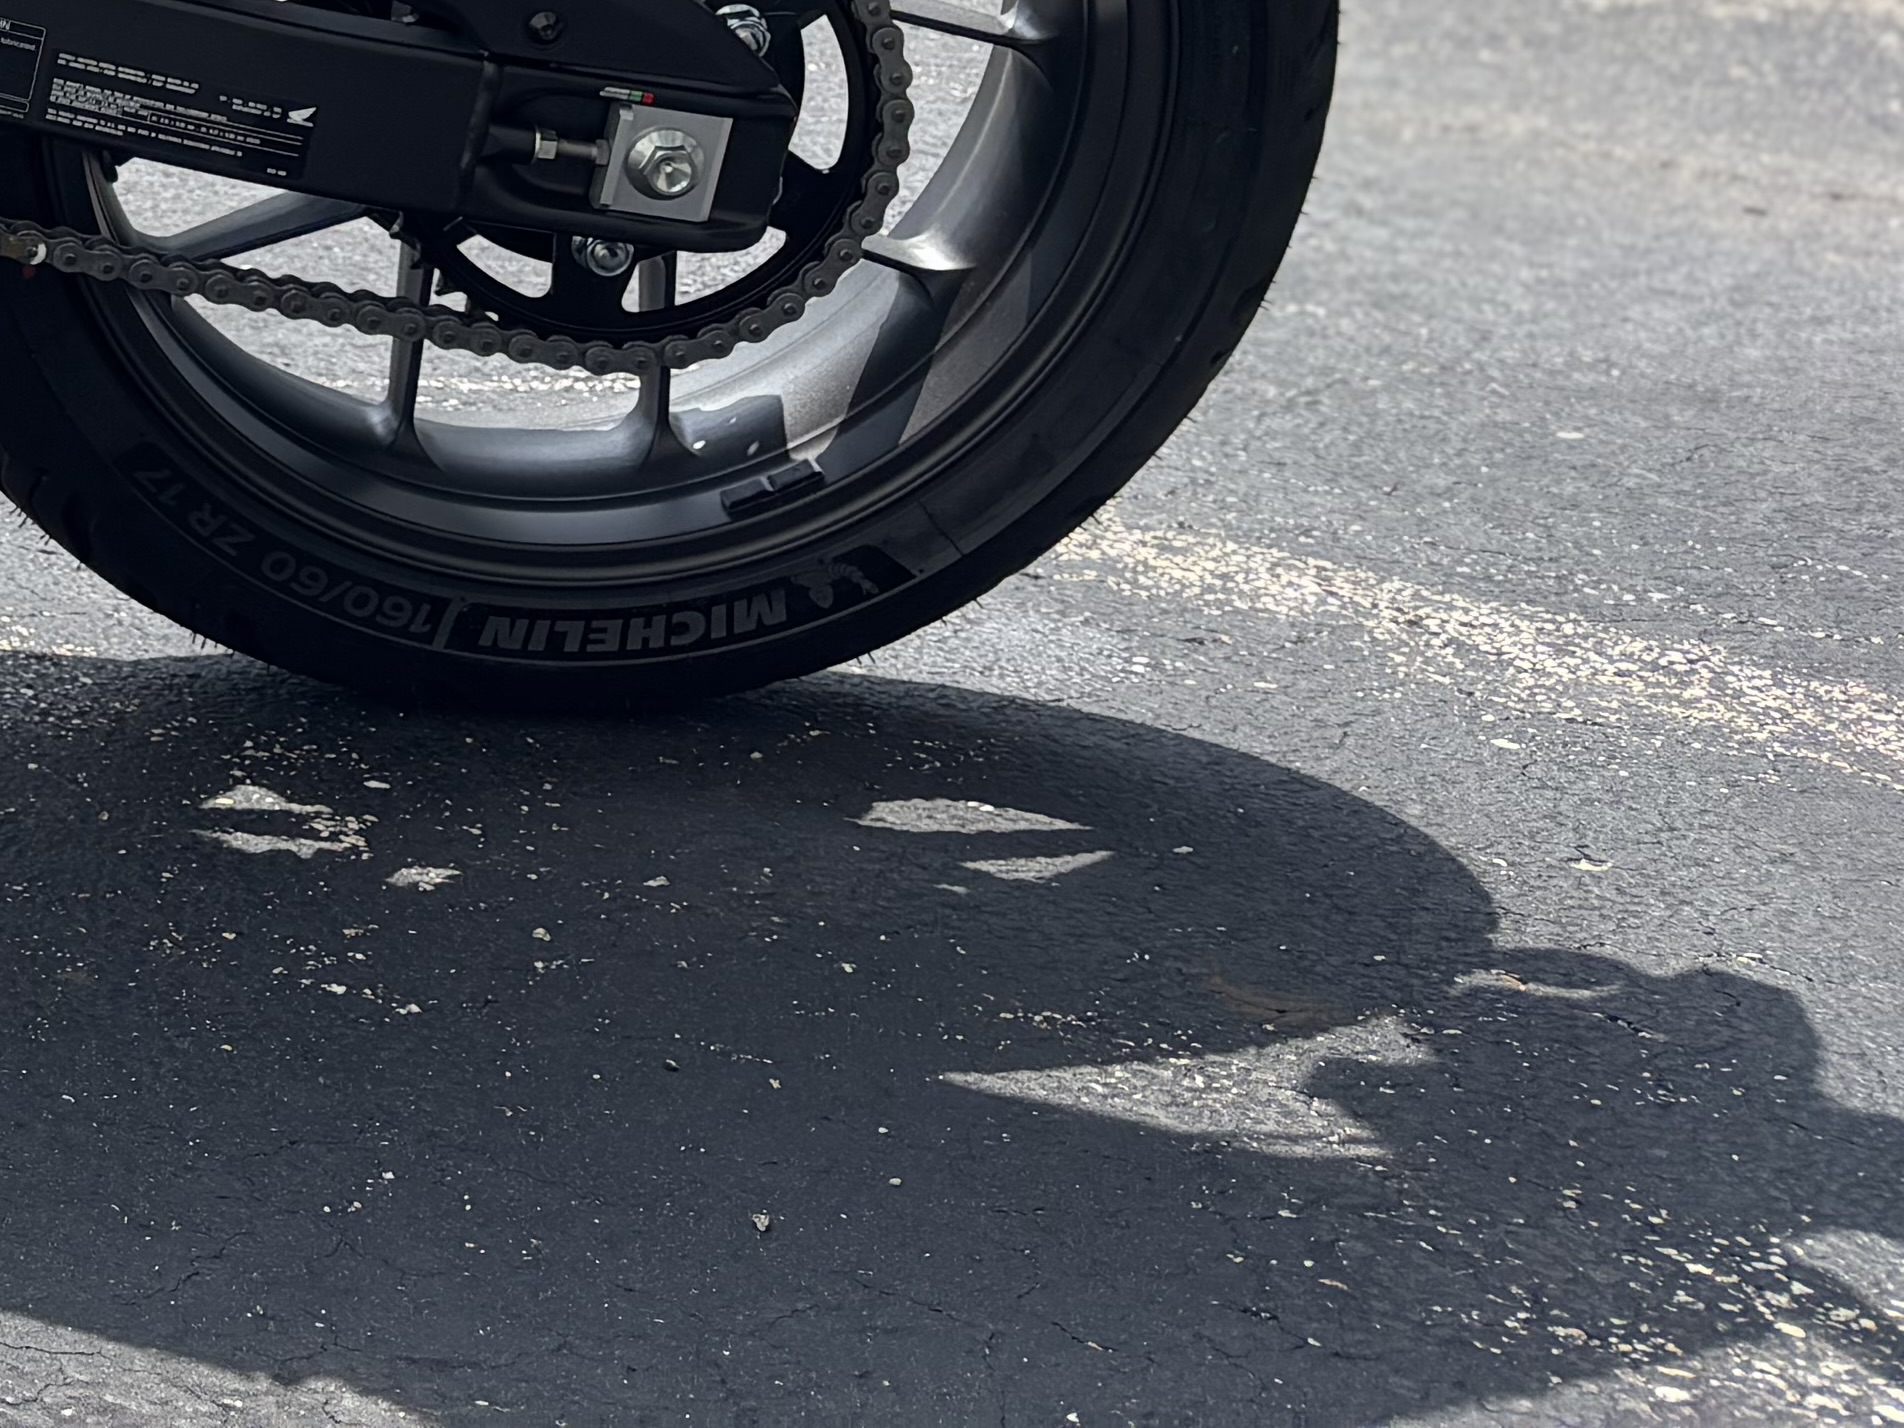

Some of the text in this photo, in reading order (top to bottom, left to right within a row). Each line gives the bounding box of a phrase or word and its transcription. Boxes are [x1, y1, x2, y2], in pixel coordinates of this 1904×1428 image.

[137, 467, 788, 652] MICHELIN 160/60 ZR 17
